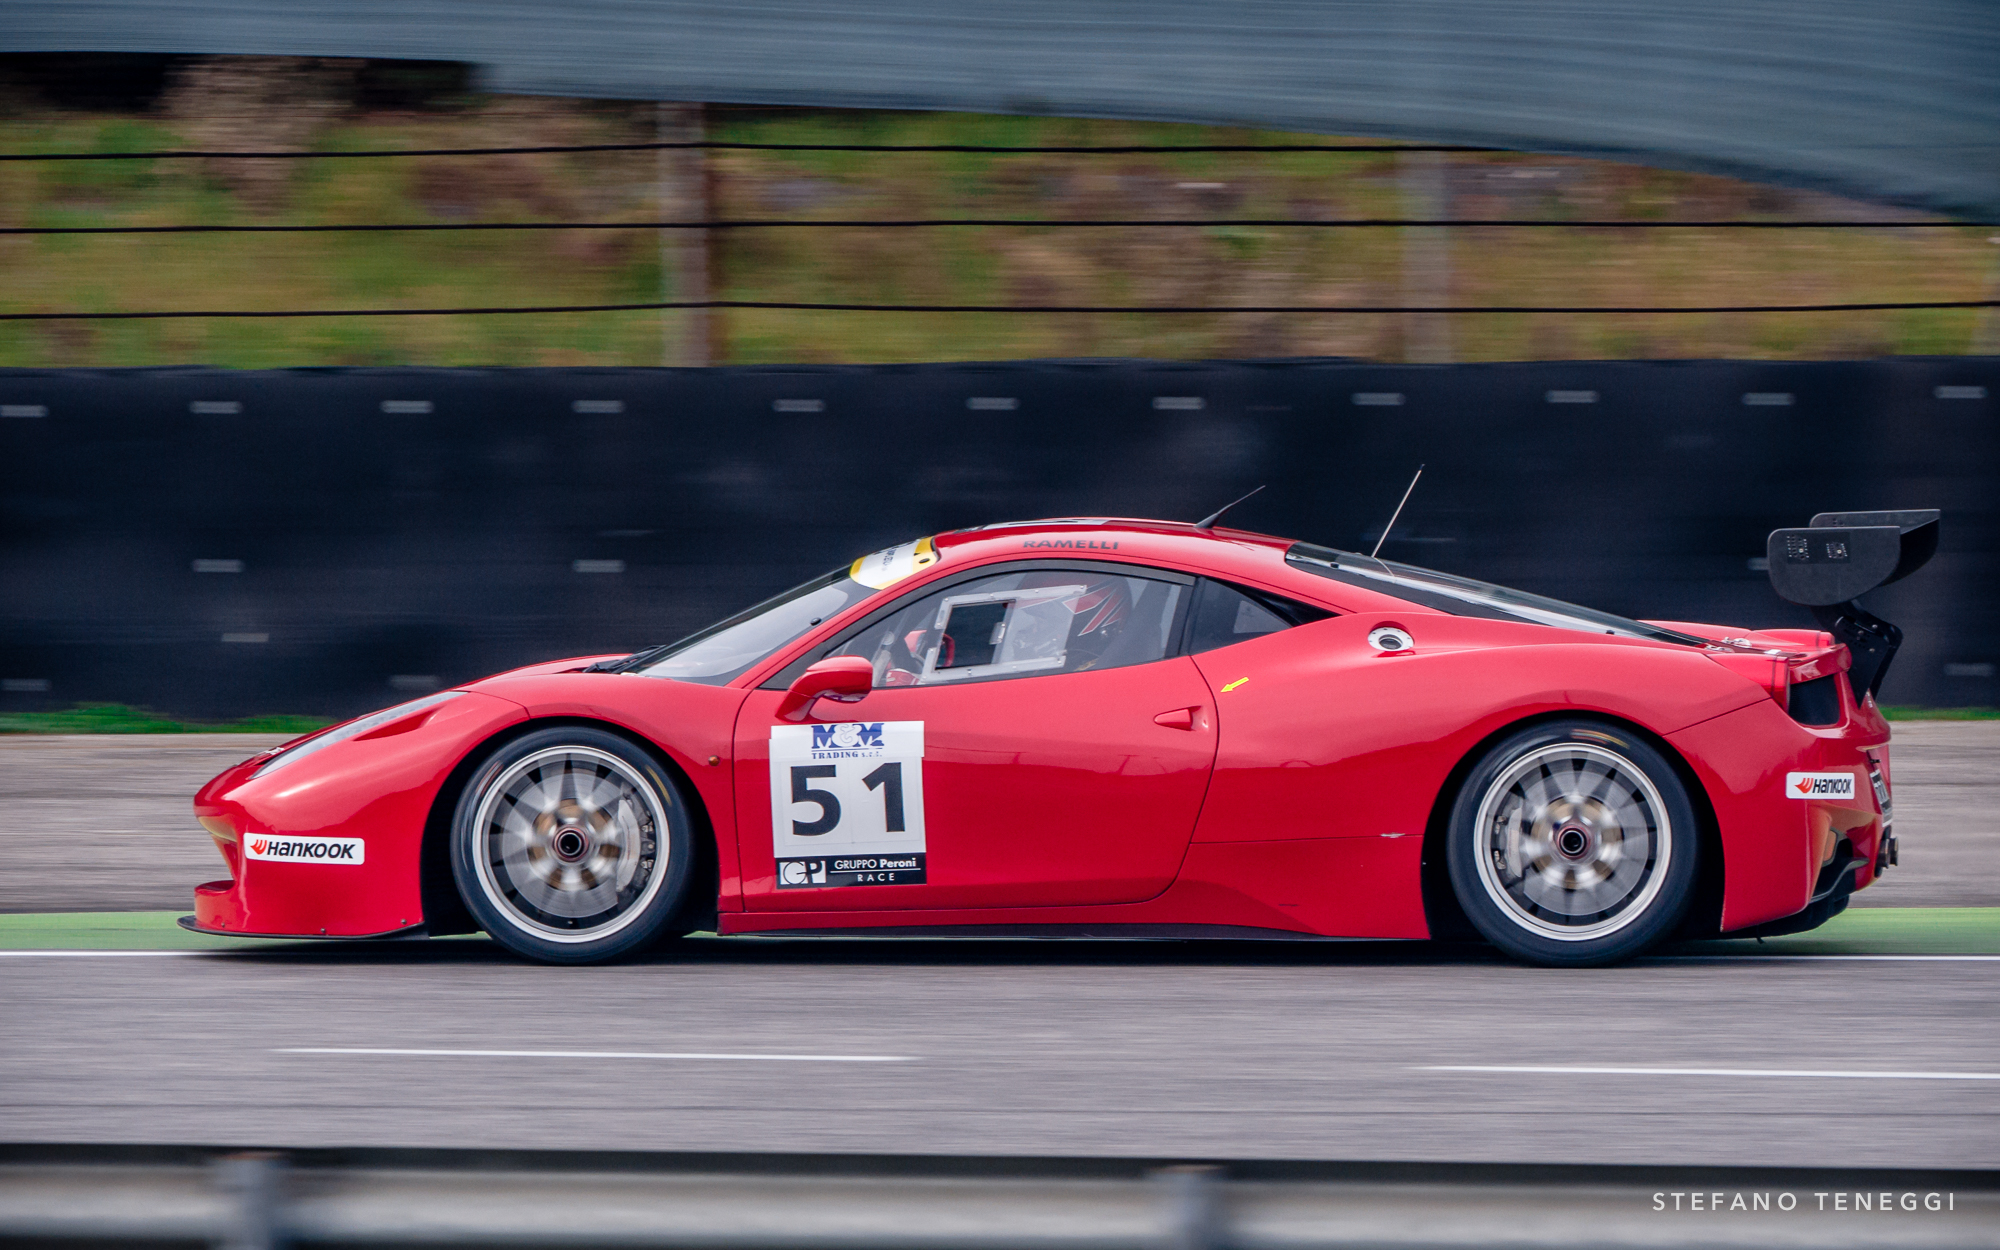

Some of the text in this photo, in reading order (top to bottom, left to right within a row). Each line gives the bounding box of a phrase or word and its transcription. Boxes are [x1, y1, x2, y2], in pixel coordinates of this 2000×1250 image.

[1023, 540, 1119, 550] RAMELLI
[811, 723, 885, 749] M&M
[811, 751, 858, 759] TRADING
[790, 762, 905, 836] 51
[834, 858, 916, 869] GRUPPO Peroni
[857, 873, 895, 882] RACE
